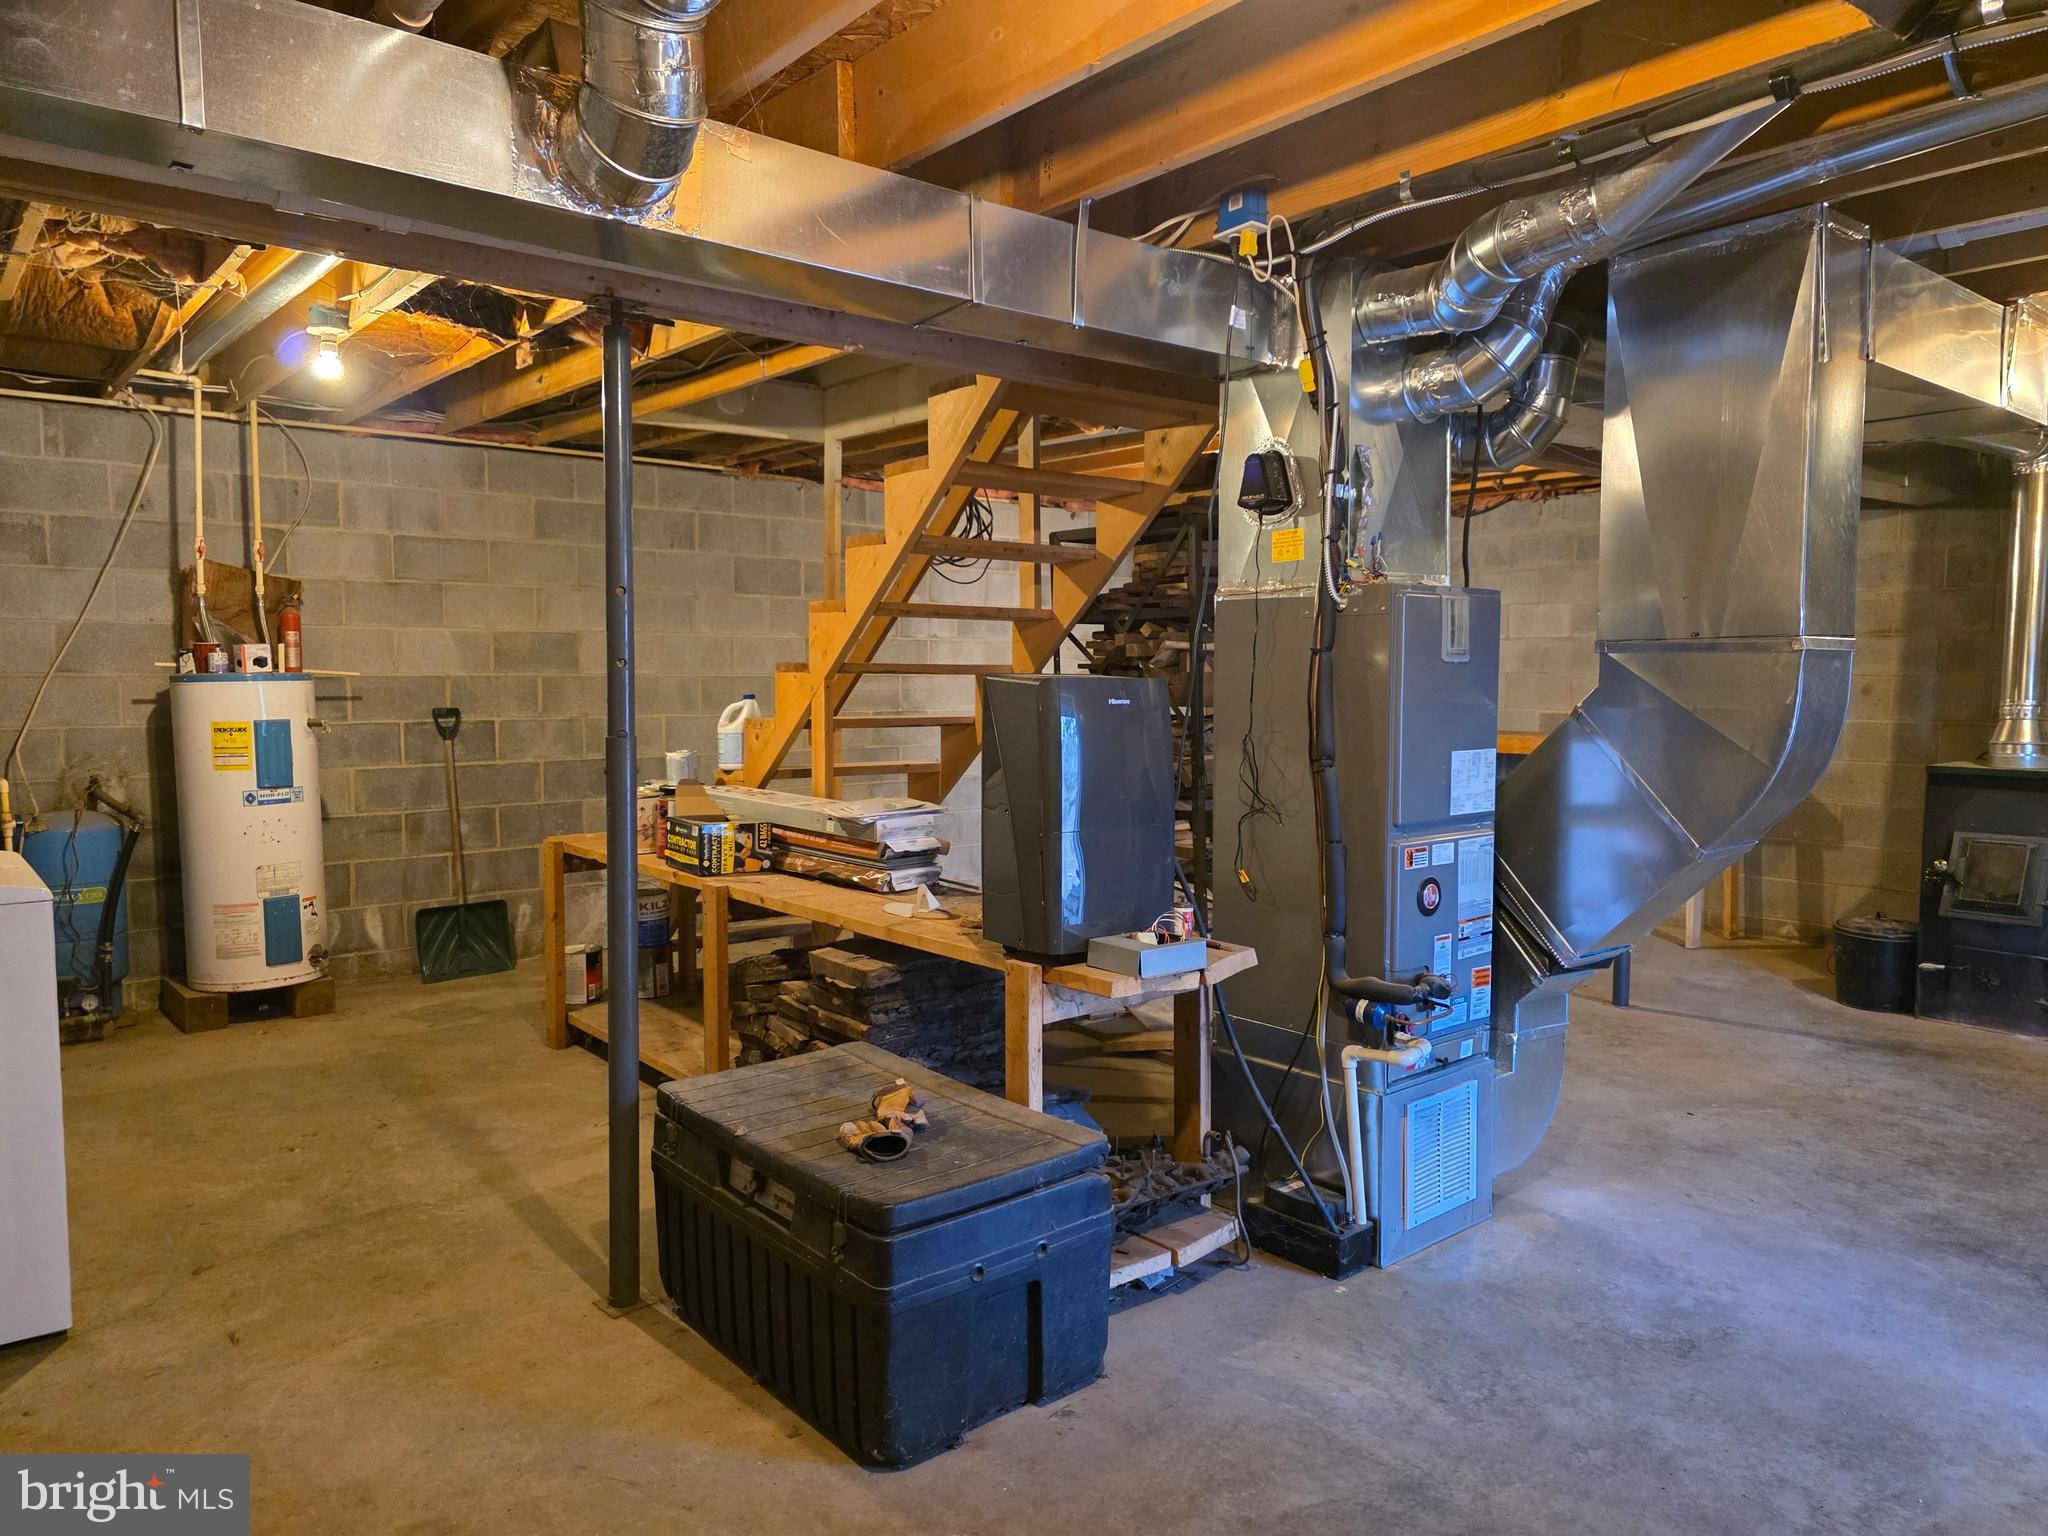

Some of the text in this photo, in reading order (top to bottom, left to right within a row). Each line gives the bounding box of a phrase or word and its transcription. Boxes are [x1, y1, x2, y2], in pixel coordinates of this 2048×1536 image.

[760, 823, 768, 839] BAGS
[667, 834, 696, 850] CONTRACTOR
[639, 900, 667, 911] KILZ
